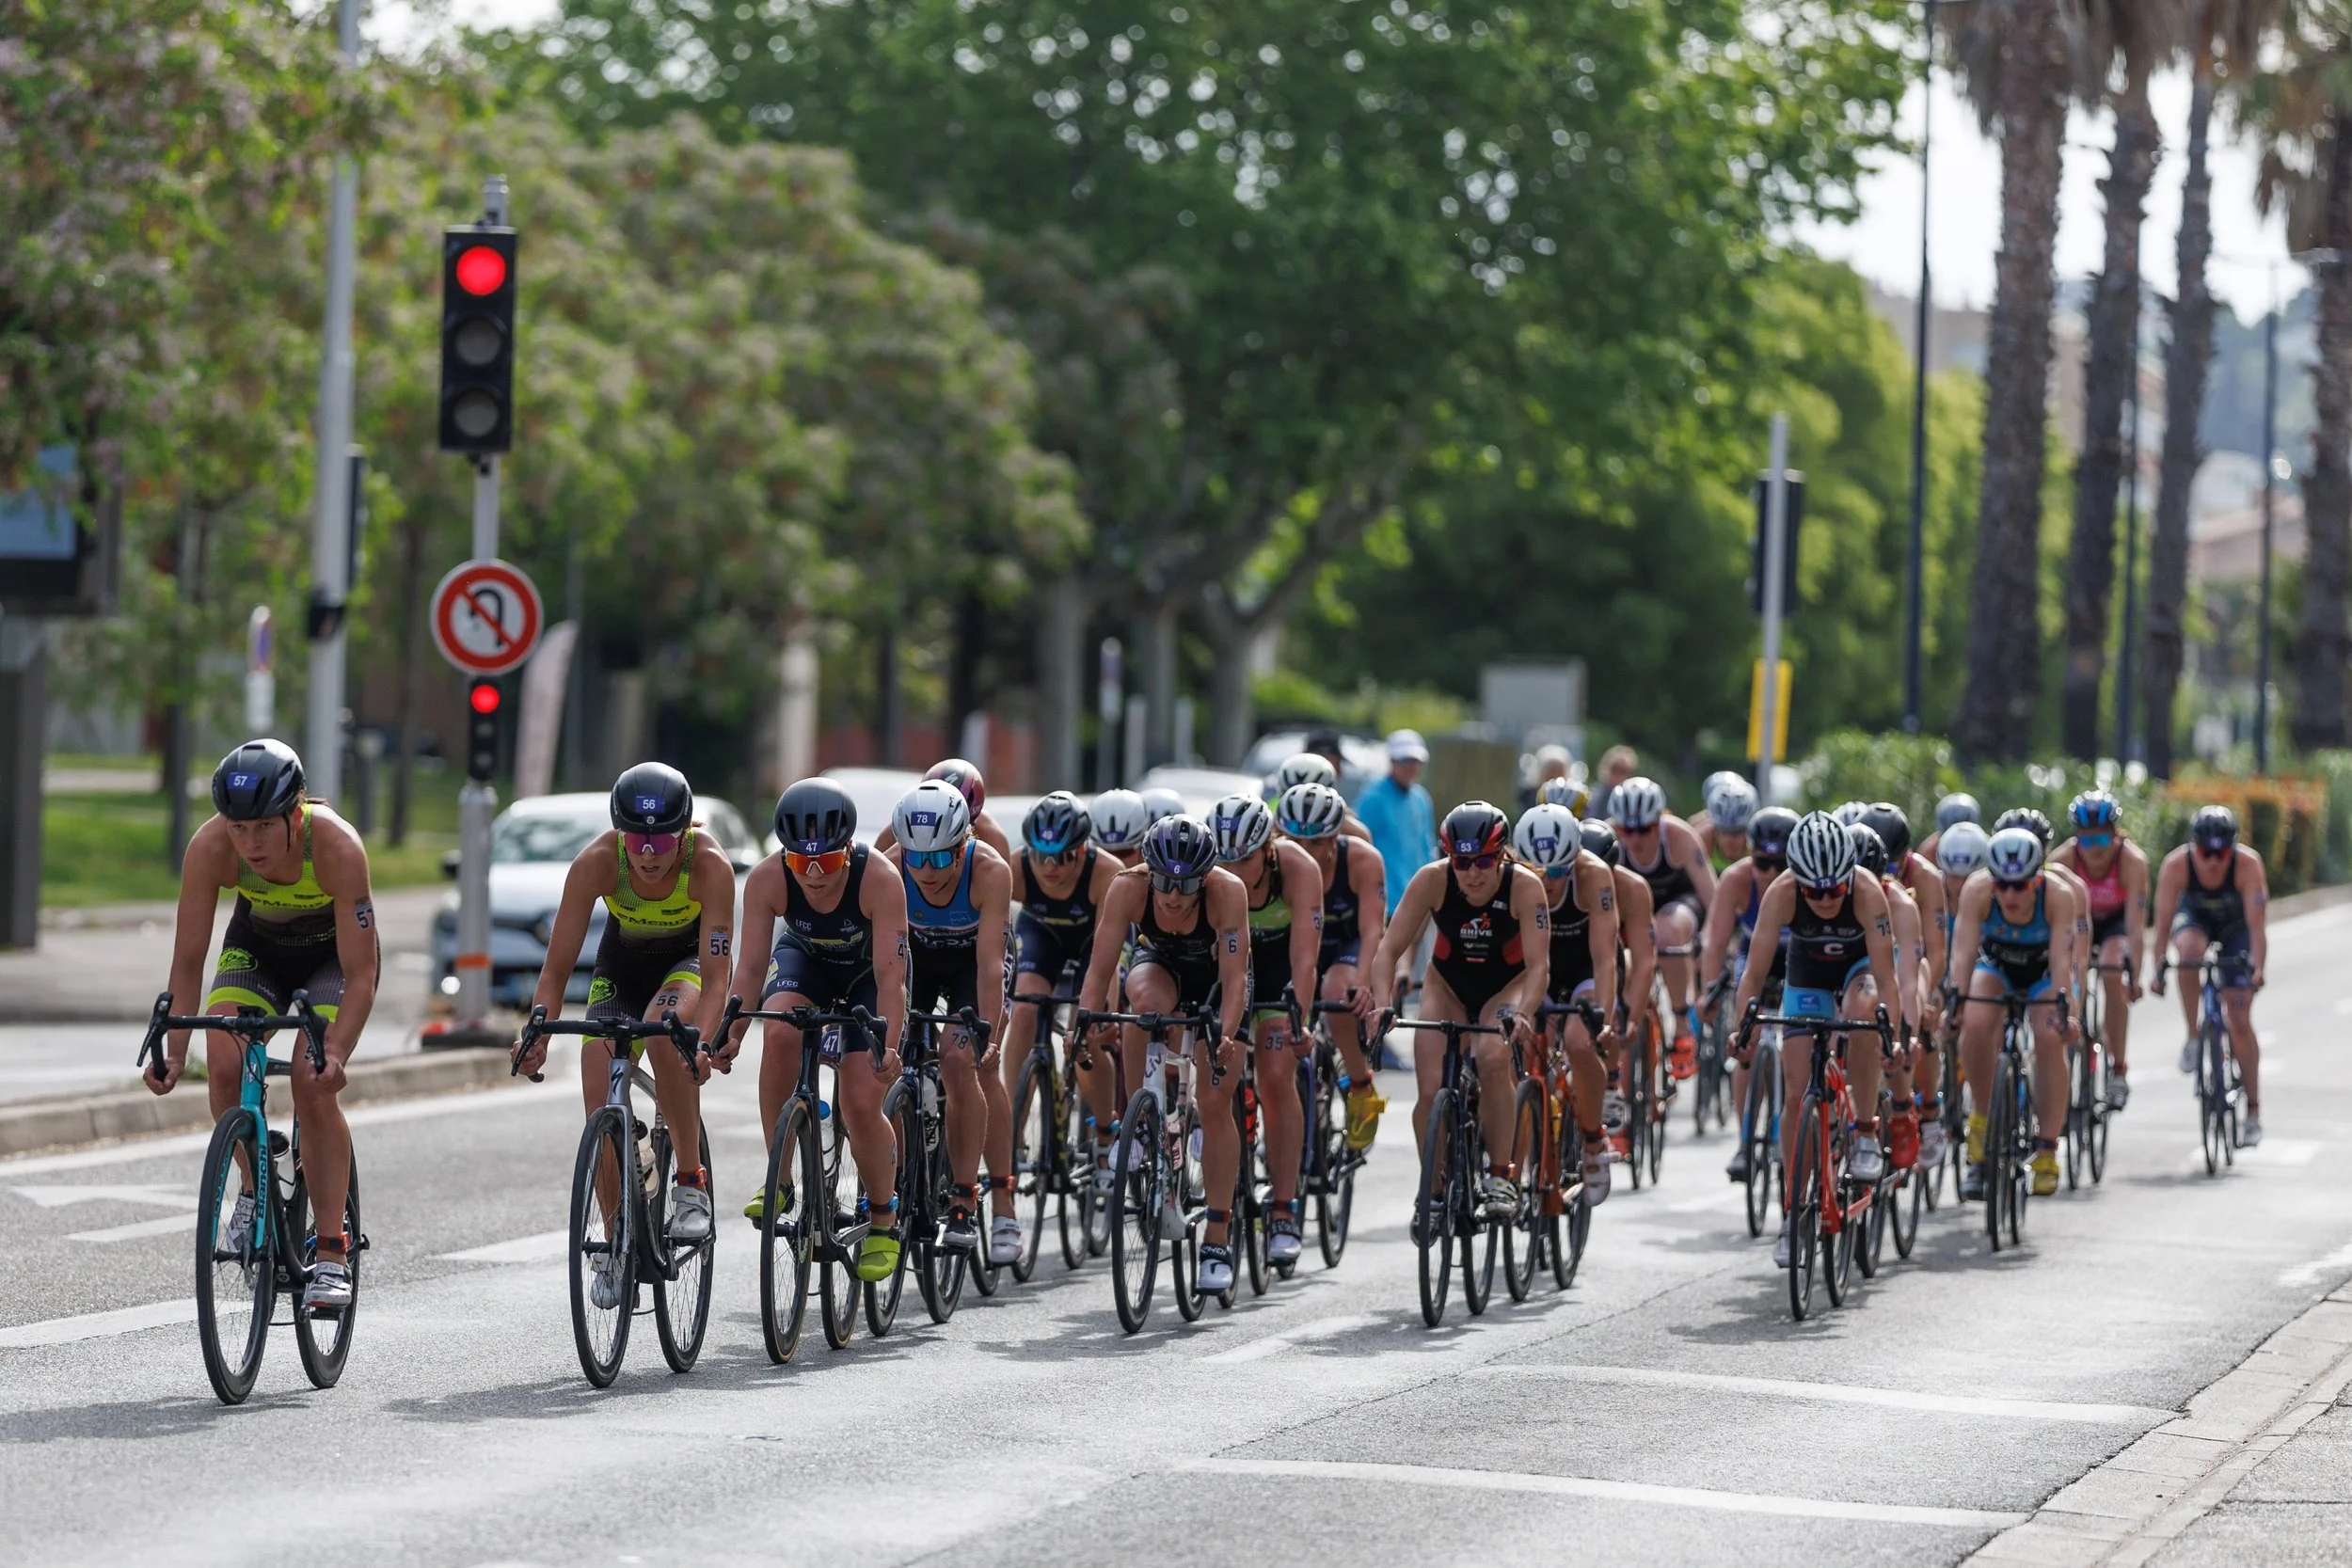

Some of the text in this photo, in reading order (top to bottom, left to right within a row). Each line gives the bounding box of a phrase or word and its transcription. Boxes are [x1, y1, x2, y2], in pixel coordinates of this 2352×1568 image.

[233, 775, 247, 786] 57
[642, 799, 656, 810] 56
[916, 814, 929, 824] 78
[805, 842, 818, 852] 47
[1460, 843, 1472, 852] 53
[1173, 864, 1181, 874] 6
[629, 916, 691, 927] Meaux
[795, 919, 812, 930] LFCC
[710, 939, 729, 957] 56
[1228, 939, 1237, 953] 6
[656, 995, 678, 1006] 56
[823, 1035, 838, 1052] 47
[951, 1033, 969, 1050] 78
[1265, 1036, 1283, 1051] 35
[1145, 1053, 1163, 1079] Liv
[257, 1144, 267, 1219] Bianchi
